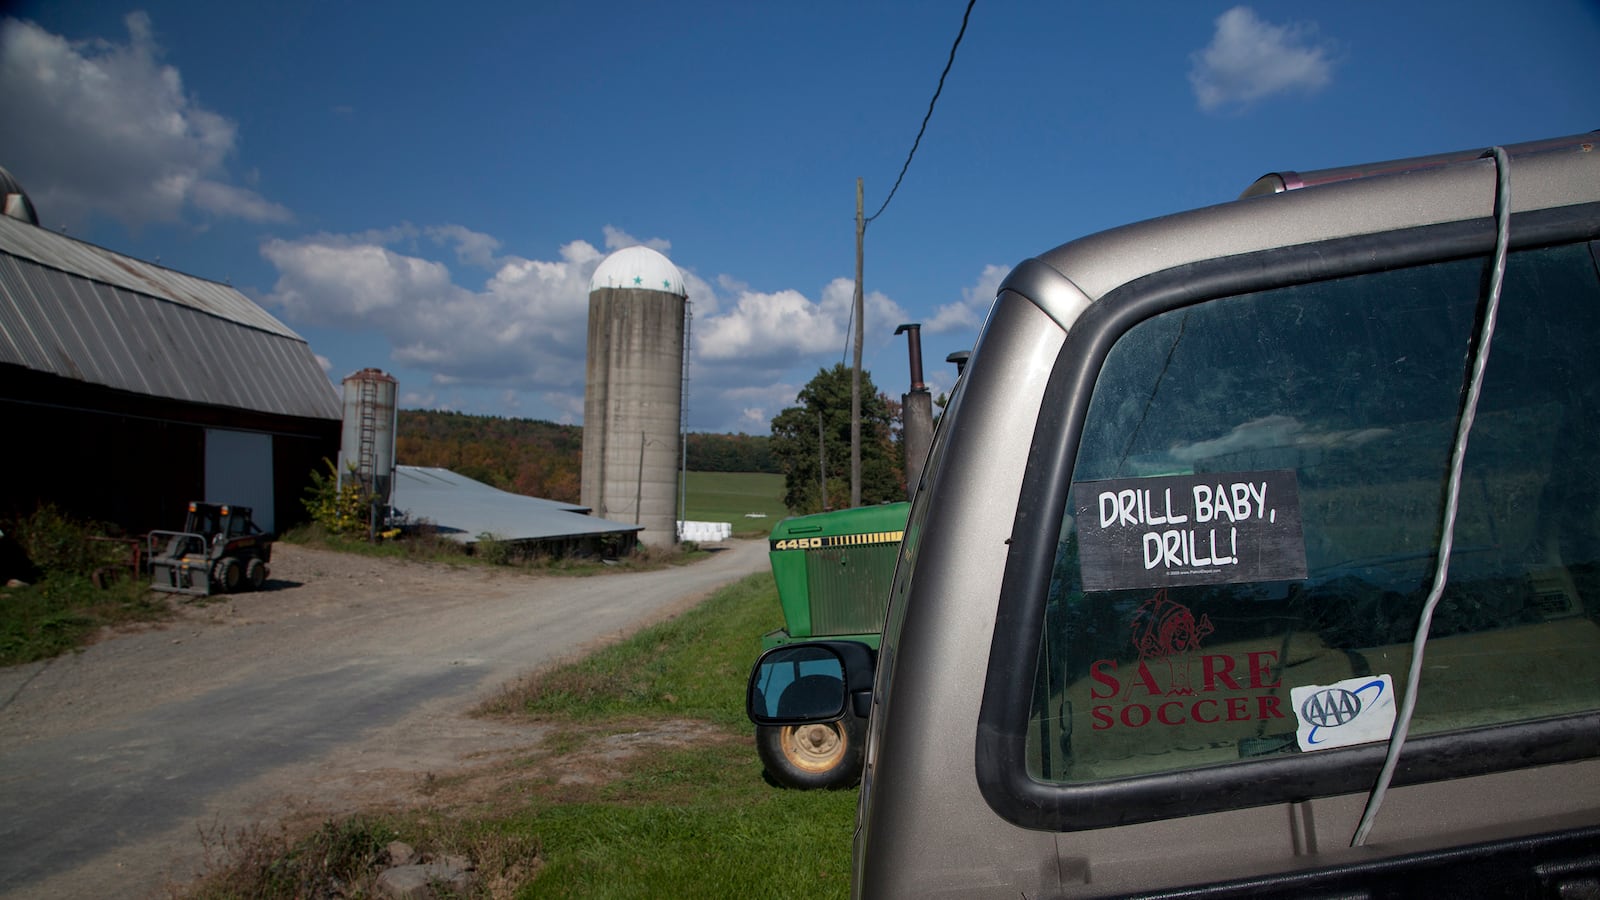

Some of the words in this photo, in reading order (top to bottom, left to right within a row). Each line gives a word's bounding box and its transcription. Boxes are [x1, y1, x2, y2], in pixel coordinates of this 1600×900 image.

[1099, 488, 1188, 529] DRILL
[1193, 481, 1276, 524] BABY,
[775, 538, 822, 550] 4450
[1142, 526, 1239, 570] DRILL!
[1092, 696, 1285, 731] SOCCER
[1309, 689, 1357, 727] AAA
